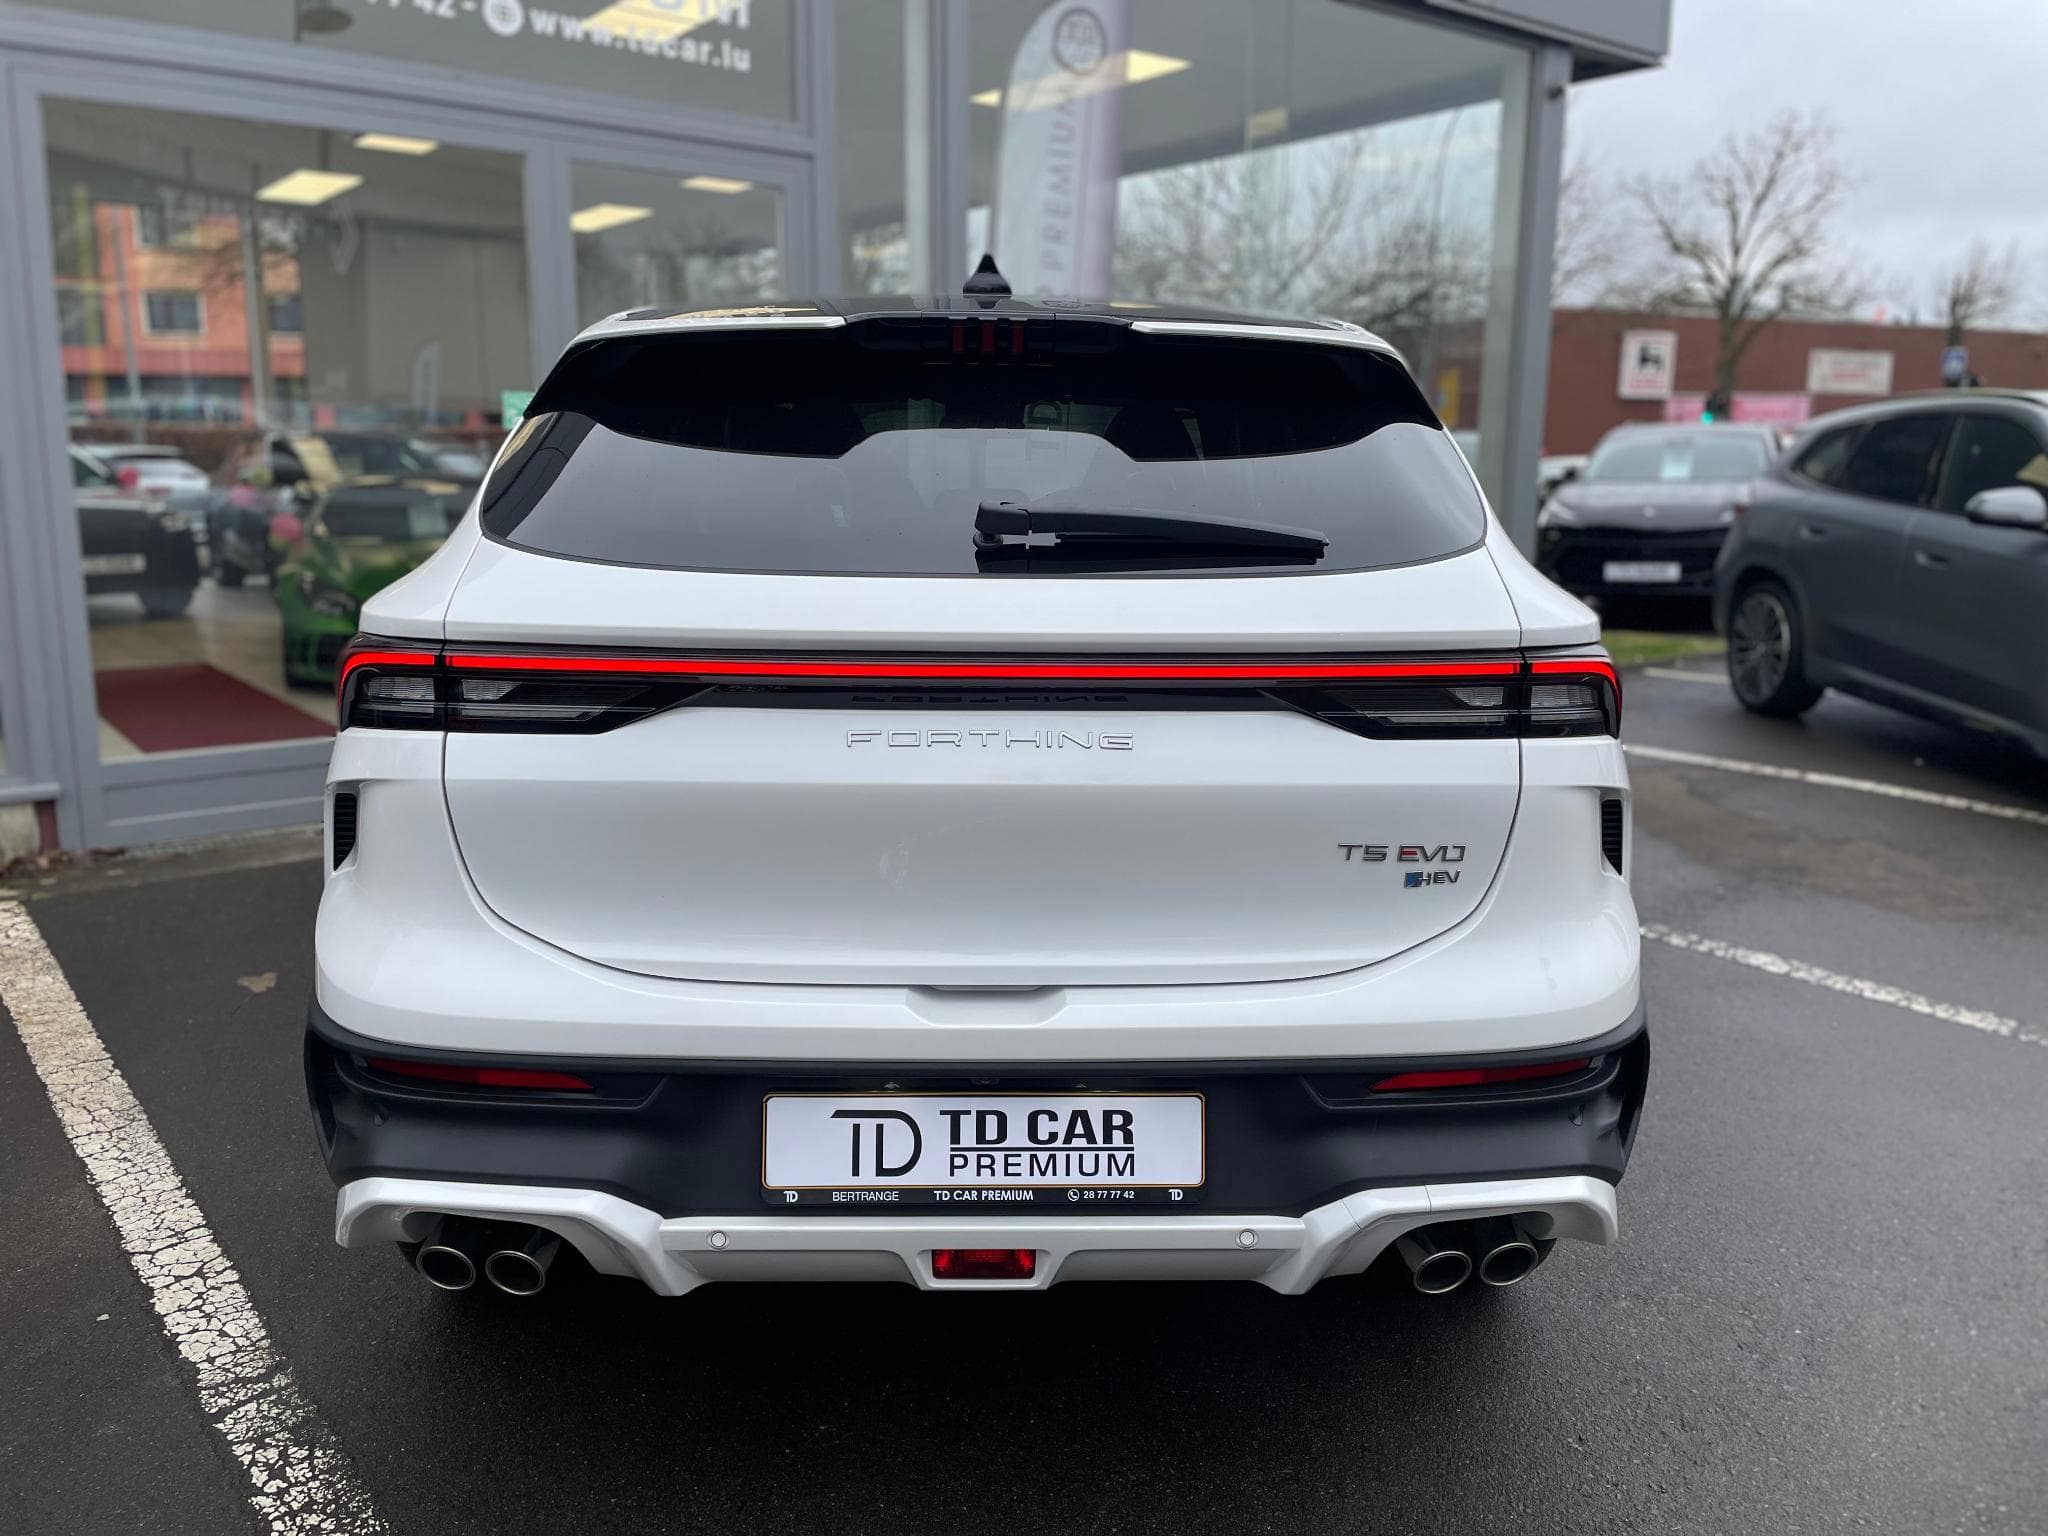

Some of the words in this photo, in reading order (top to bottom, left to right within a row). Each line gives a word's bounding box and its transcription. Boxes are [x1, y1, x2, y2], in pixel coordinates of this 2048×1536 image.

[847, 729, 1133, 750] FORTHING
[939, 1110, 1008, 1145] TD
[1027, 1110, 1134, 1145] CAR
[830, 1109, 922, 1177] TD
[949, 1153, 1135, 1177] PREMIUM
[783, 1190, 799, 1203] TD
[832, 1191, 899, 1202] BERTRANGE
[934, 1190, 950, 1201] TD
[953, 1190, 978, 1201] CAR
[981, 1190, 1034, 1201] PREMIUM
[1083, 1190, 1095, 1199] 28
[1097, 1190, 1108, 1199] 77
[1110, 1190, 1121, 1199] 77
[1123, 1190, 1135, 1199] 42
[1168, 1188, 1184, 1201] TD
